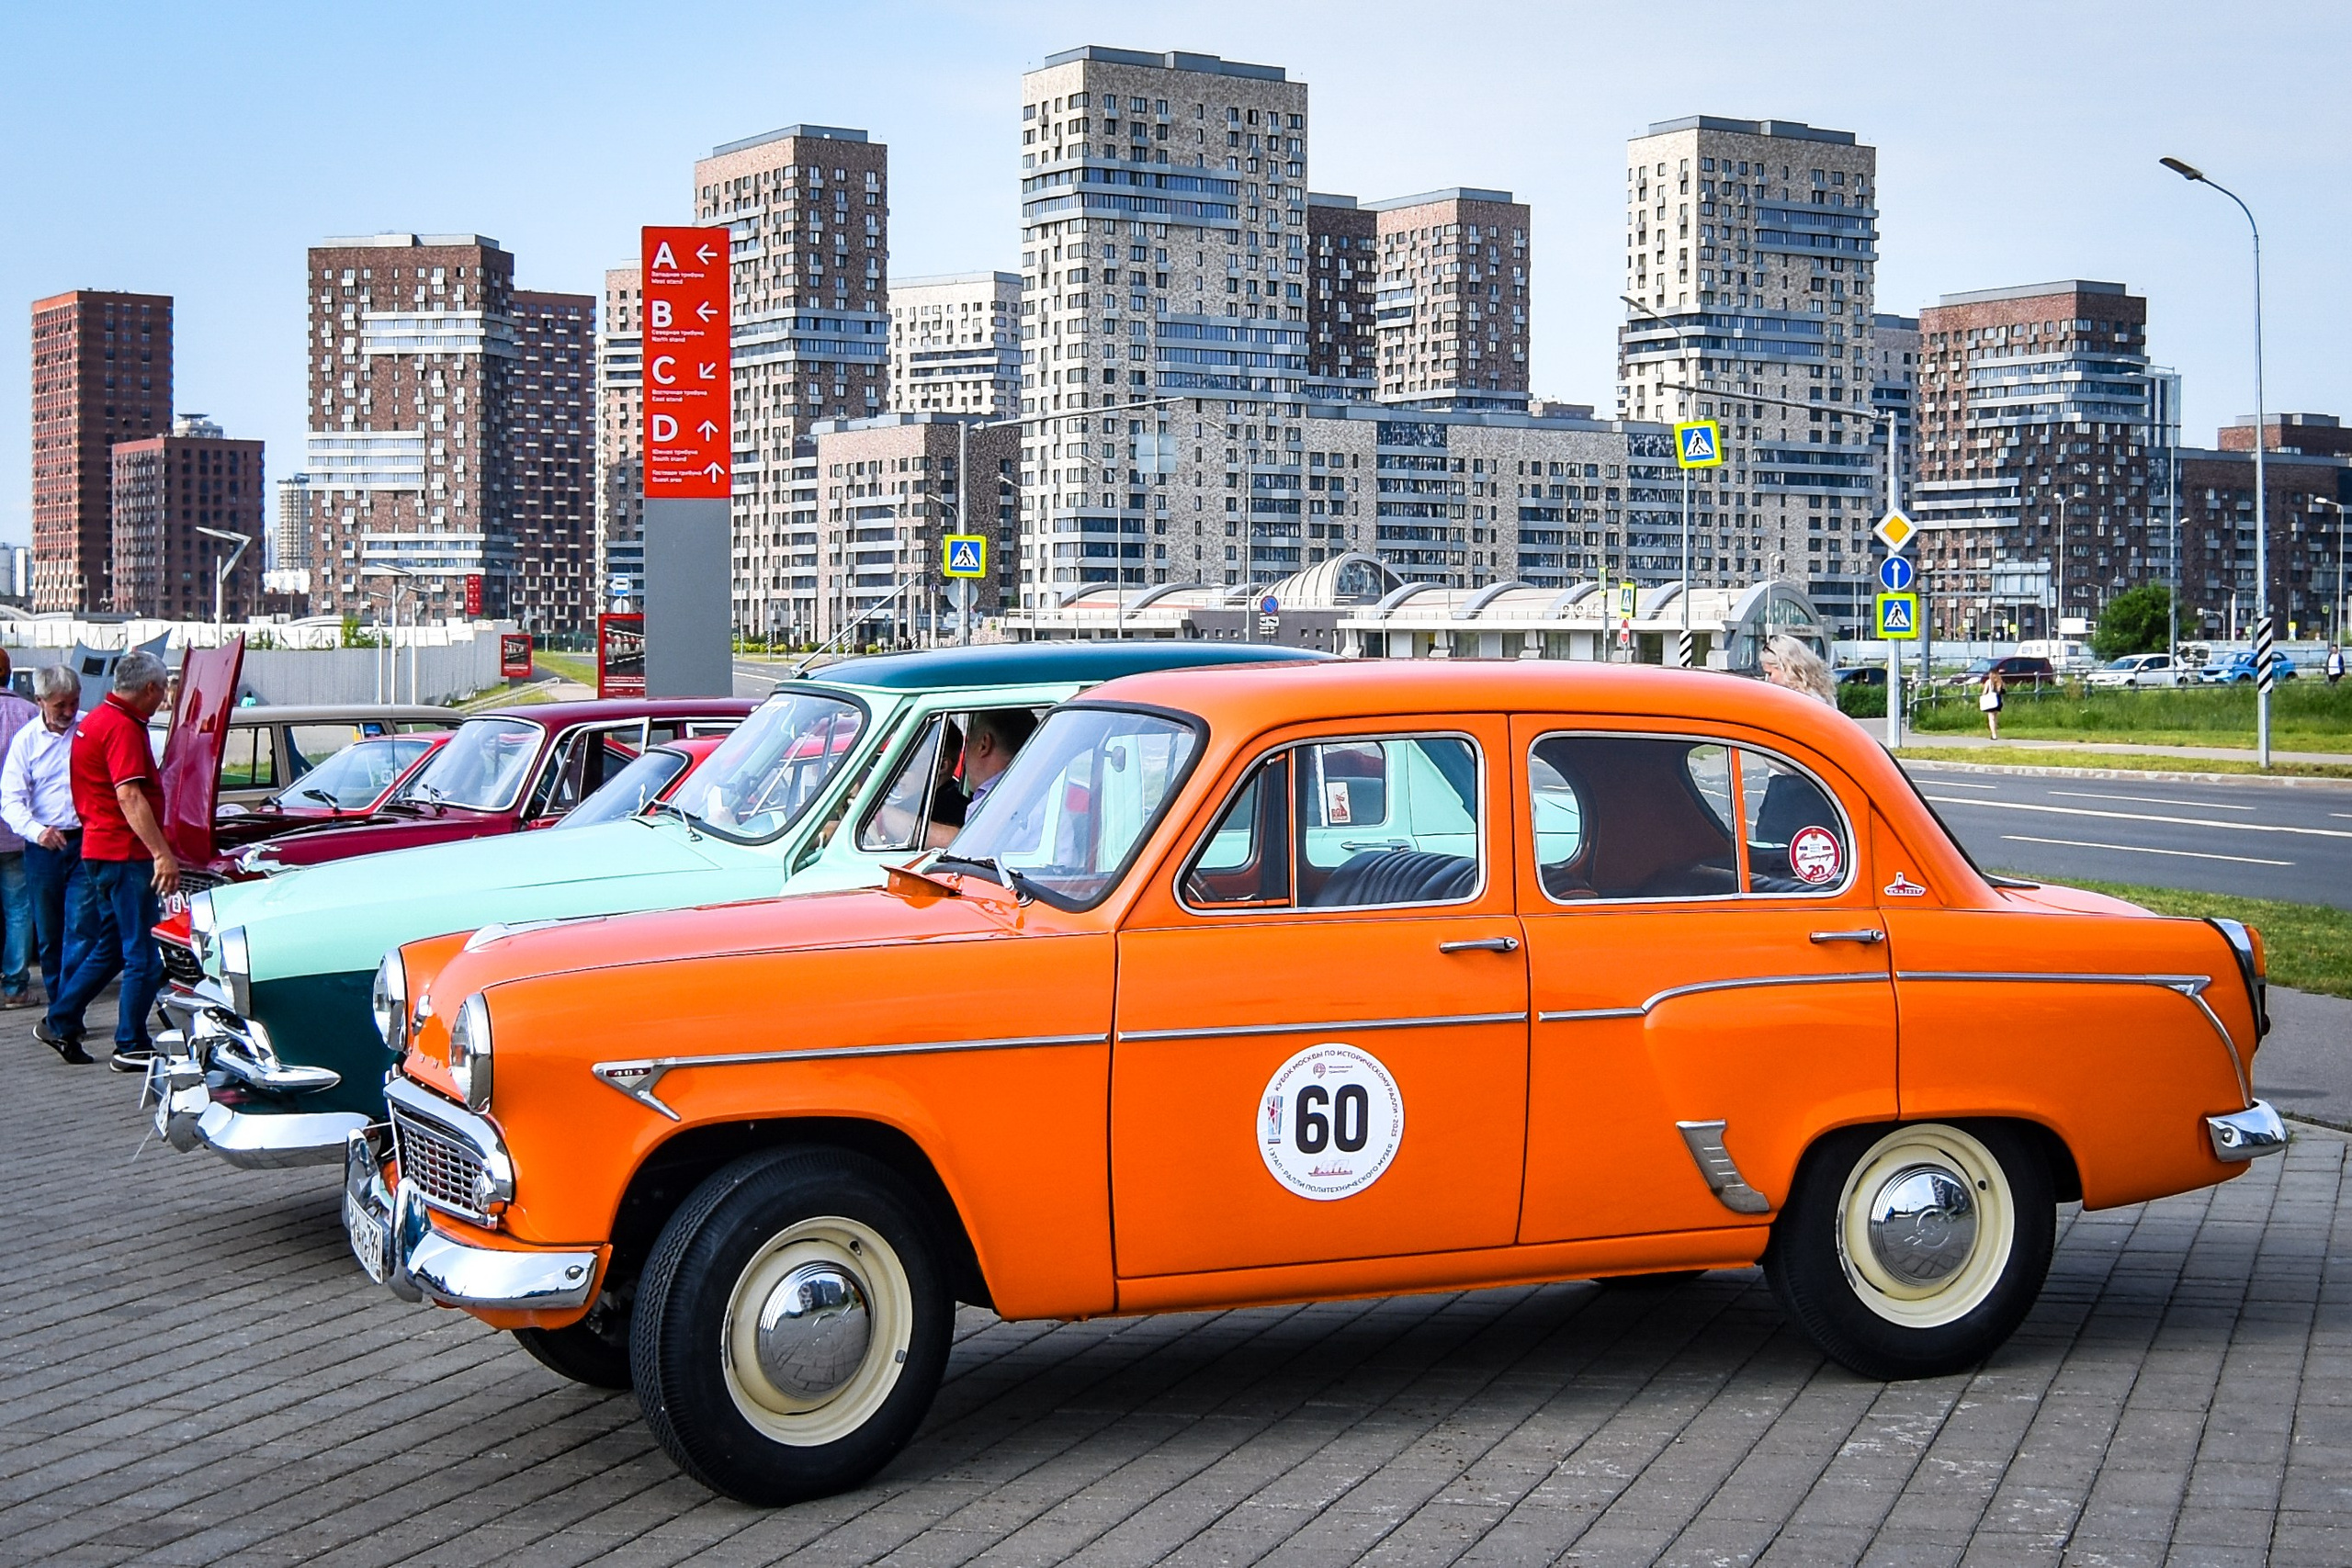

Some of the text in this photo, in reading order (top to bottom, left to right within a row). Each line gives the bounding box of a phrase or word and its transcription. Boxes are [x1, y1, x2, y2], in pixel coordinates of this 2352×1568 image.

[651, 242, 678, 269] A
[651, 300, 673, 328] B
[651, 355, 676, 385] C
[651, 414, 679, 442] D
[1274, 1067, 1295, 1092] КУБОК
[1292, 1051, 1323, 1071] МОСКВЫ
[1337, 1049, 1390, 1087] ИСТОРИЧЕСКОМУ
[1387, 1088, 1398, 1114] РАЛЛИ
[1295, 1084, 1368, 1154] 60
[1269, 1150, 1283, 1169] ЭТАП
[1283, 1169, 1306, 1188] РАЛЛИ
[1305, 1166, 1379, 1193] ПОЛИТЕХНИЧЕСКОГО
[1377, 1143, 1394, 1167] МУЗЕЯ
